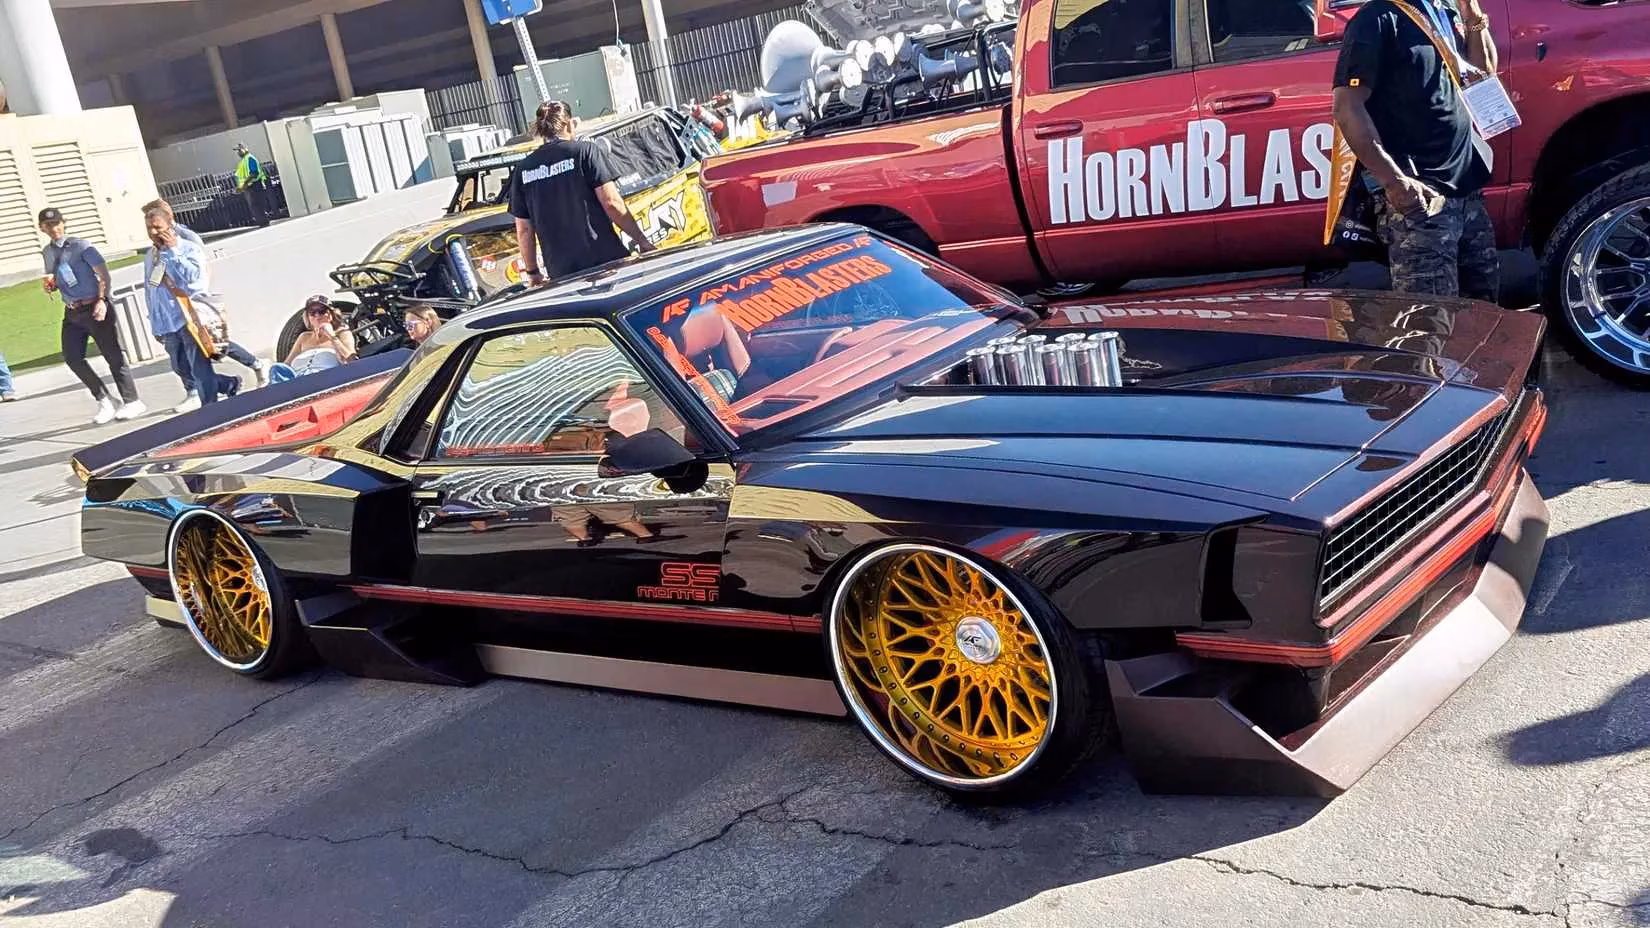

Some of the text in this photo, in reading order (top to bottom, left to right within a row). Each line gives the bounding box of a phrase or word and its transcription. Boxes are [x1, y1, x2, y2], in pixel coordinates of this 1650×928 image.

[1047, 118, 1334, 224] HORNBLAS
[716, 255, 892, 332] HORNBLASTERS
[661, 562, 721, 588] SS
